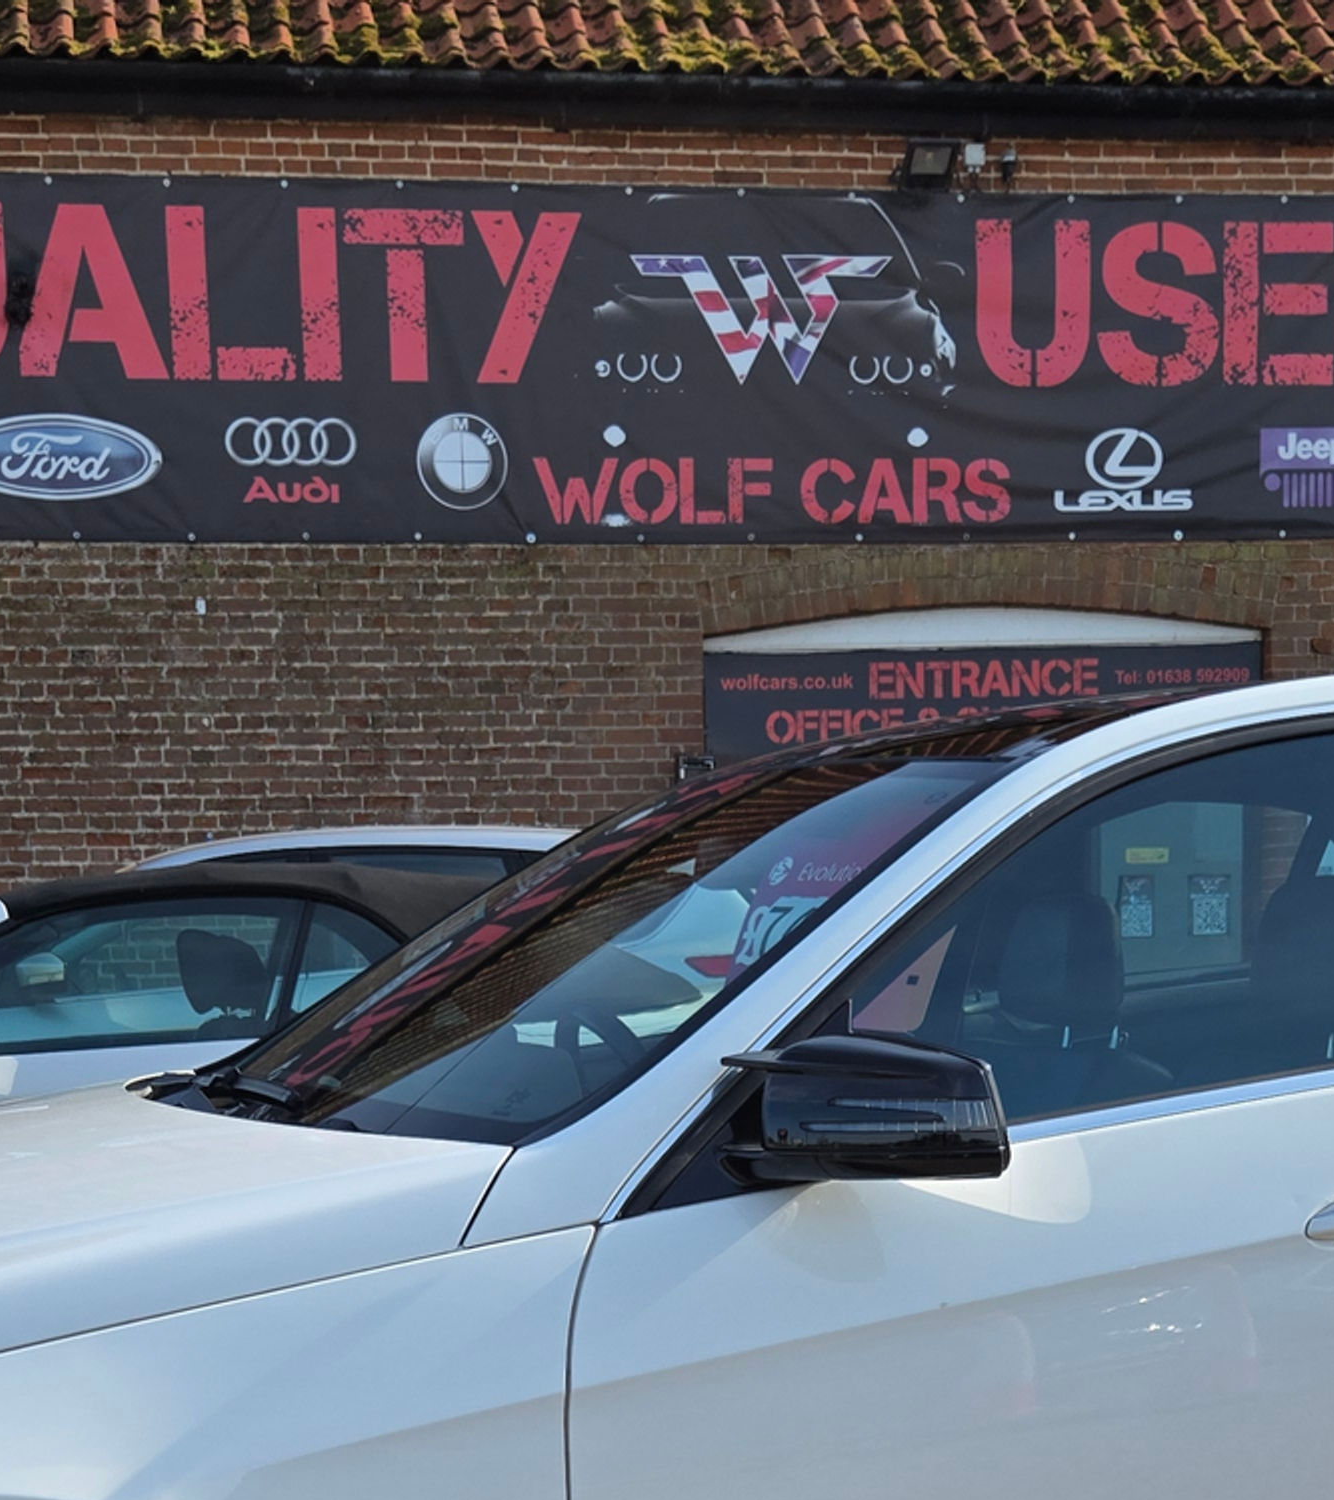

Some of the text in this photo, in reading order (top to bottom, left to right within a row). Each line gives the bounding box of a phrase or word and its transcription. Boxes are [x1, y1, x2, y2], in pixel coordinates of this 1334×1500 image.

[0, 431, 114, 481] Ford
[244, 475, 341, 503] Audi
[533, 457, 1011, 526] WOLF CARS
[1054, 489, 1193, 512] LEXUS
[720, 671, 854, 691] wolfcars.co.uk
[869, 658, 1098, 699] ENTRANCE
[1115, 669, 1142, 684] Tel:
[765, 707, 905, 744] OFFICE
